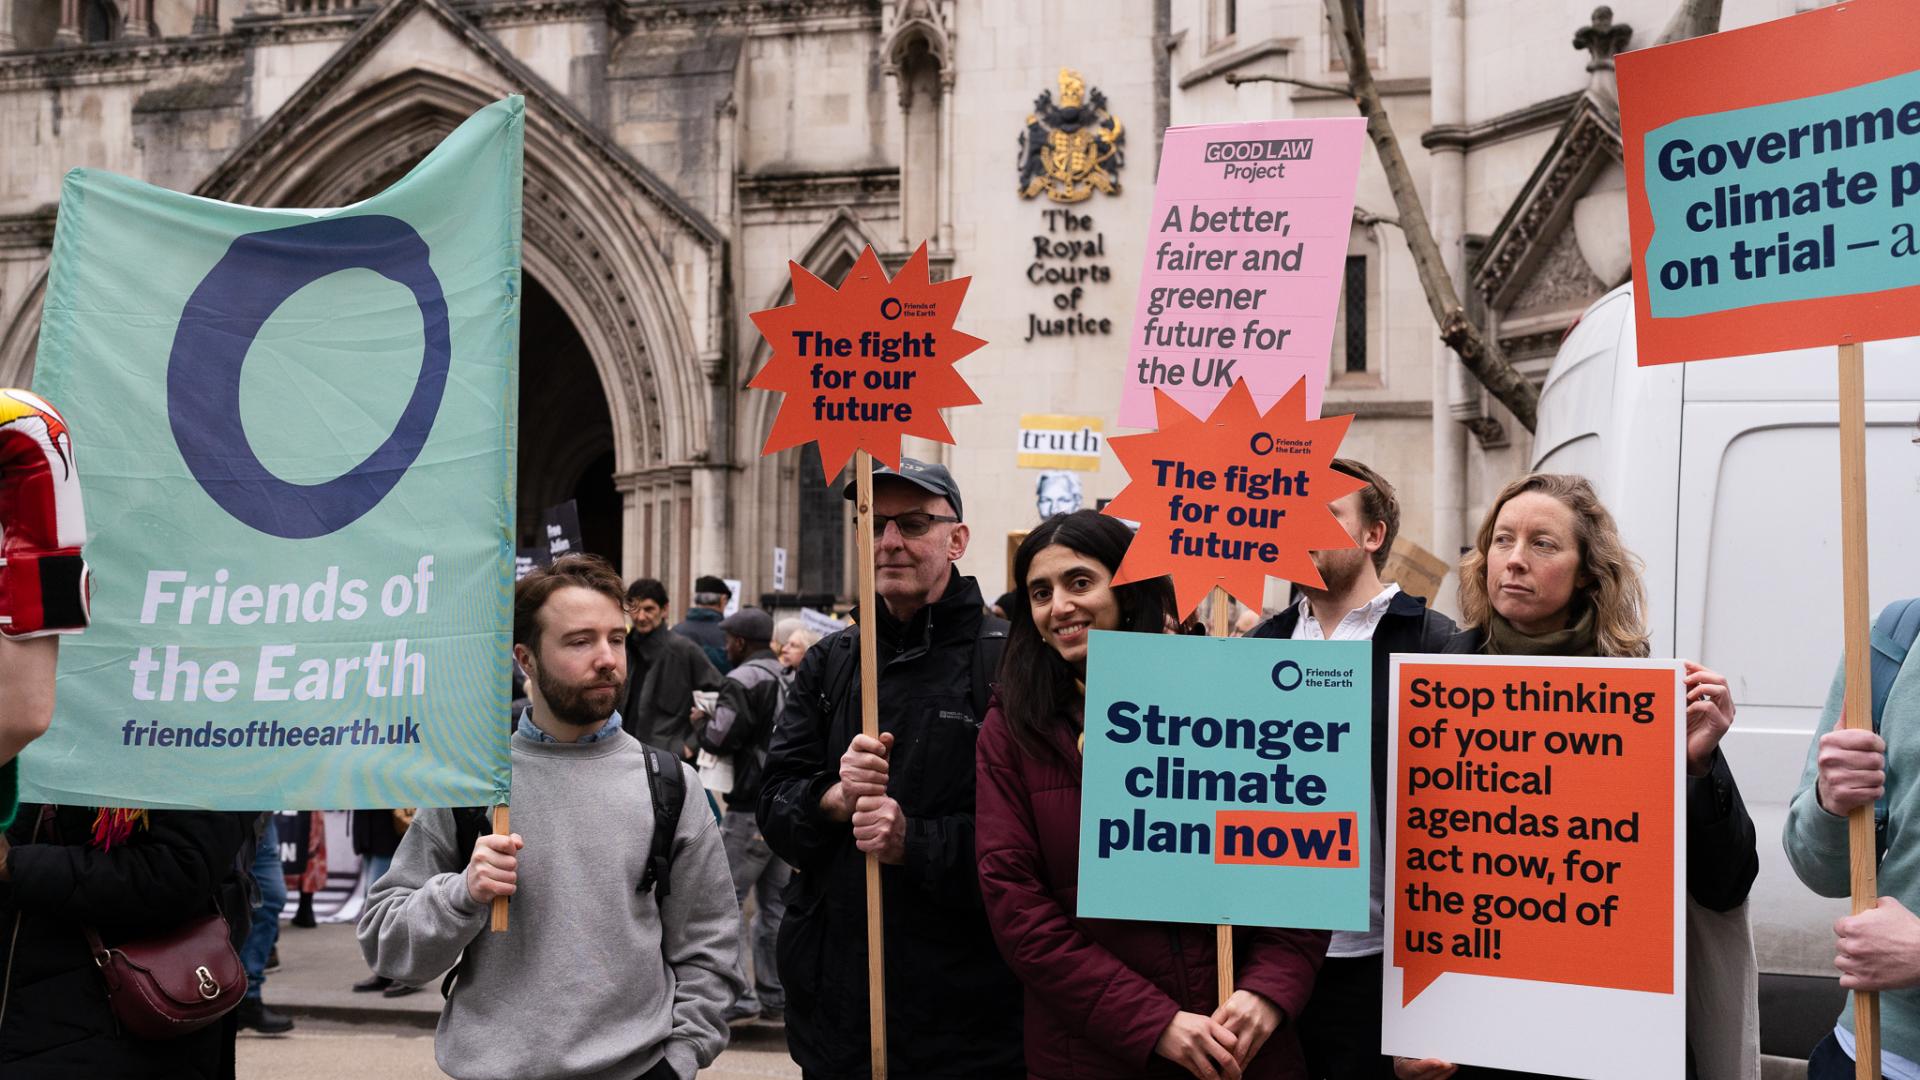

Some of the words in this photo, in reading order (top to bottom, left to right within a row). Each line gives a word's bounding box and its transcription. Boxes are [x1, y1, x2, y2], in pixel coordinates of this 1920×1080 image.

[1207, 144, 1263, 160] GOOD
[1267, 141, 1310, 158] LAW
[1224, 163, 1285, 183] Project
[1685, 167, 1877, 234] climate
[1043, 209, 1092, 232] The
[1161, 206, 1182, 232] A
[1190, 205, 1290, 236] better,
[1033, 235, 1104, 260] Royal
[1157, 242, 1237, 270] fairer
[1242, 243, 1303, 271] and
[1660, 255, 1718, 290] on
[1730, 224, 1835, 280] trial
[1027, 263, 1110, 284] Courts
[903, 302, 929, 310] Friends
[929, 302, 936, 310] of
[1054, 287, 1083, 310] of
[1148, 288, 1266, 315] greener
[1025, 313, 1111, 342] Justice
[1144, 318, 1236, 348] future
[1243, 320, 1291, 350] for
[792, 331, 852, 357] The
[859, 332, 935, 362] fight
[811, 364, 856, 389] for
[864, 371, 916, 389] our
[1138, 358, 1184, 385] the
[1192, 358, 1238, 387] UK
[813, 396, 912, 422] future
[1023, 428, 1100, 452] truth
[1276, 438, 1304, 447] Friends
[1305, 439, 1312, 447] of
[1276, 446, 1288, 454] the
[1289, 447, 1311, 455] Earth
[1152, 460, 1216, 490] The
[1224, 466, 1309, 500] fight
[1169, 496, 1219, 523] for
[1227, 507, 1285, 528] our
[1169, 528, 1278, 562] future
[141, 566, 368, 624] Friends
[380, 554, 434, 617] of
[130, 647, 240, 702] the
[254, 639, 425, 701] Earth
[1305, 679, 1322, 687] the
[1324, 679, 1352, 687] Earth
[1306, 668, 1342, 677] Friends
[1343, 668, 1353, 677] of
[1410, 678, 1494, 717] Stop
[1503, 681, 1655, 723] thinking
[122, 716, 420, 747] friendsoftheearth.uk
[1106, 701, 1350, 760] Stronger
[1409, 719, 1447, 748] of
[1455, 729, 1536, 757] your
[1545, 732, 1622, 756] own
[1125, 755, 1326, 806] climate
[1409, 761, 1551, 796] political
[1099, 809, 1210, 858] plan
[1224, 819, 1351, 861] now!
[1407, 805, 1558, 839] agendas
[1568, 812, 1638, 842] and
[1407, 846, 1463, 873] act
[1473, 853, 1554, 885] now,
[1563, 850, 1621, 884] for
[1405, 882, 1464, 914] the
[1472, 893, 1566, 925] good
[1576, 895, 1618, 927] of
[1406, 930, 1443, 954] us
[1452, 928, 1500, 960] all!
